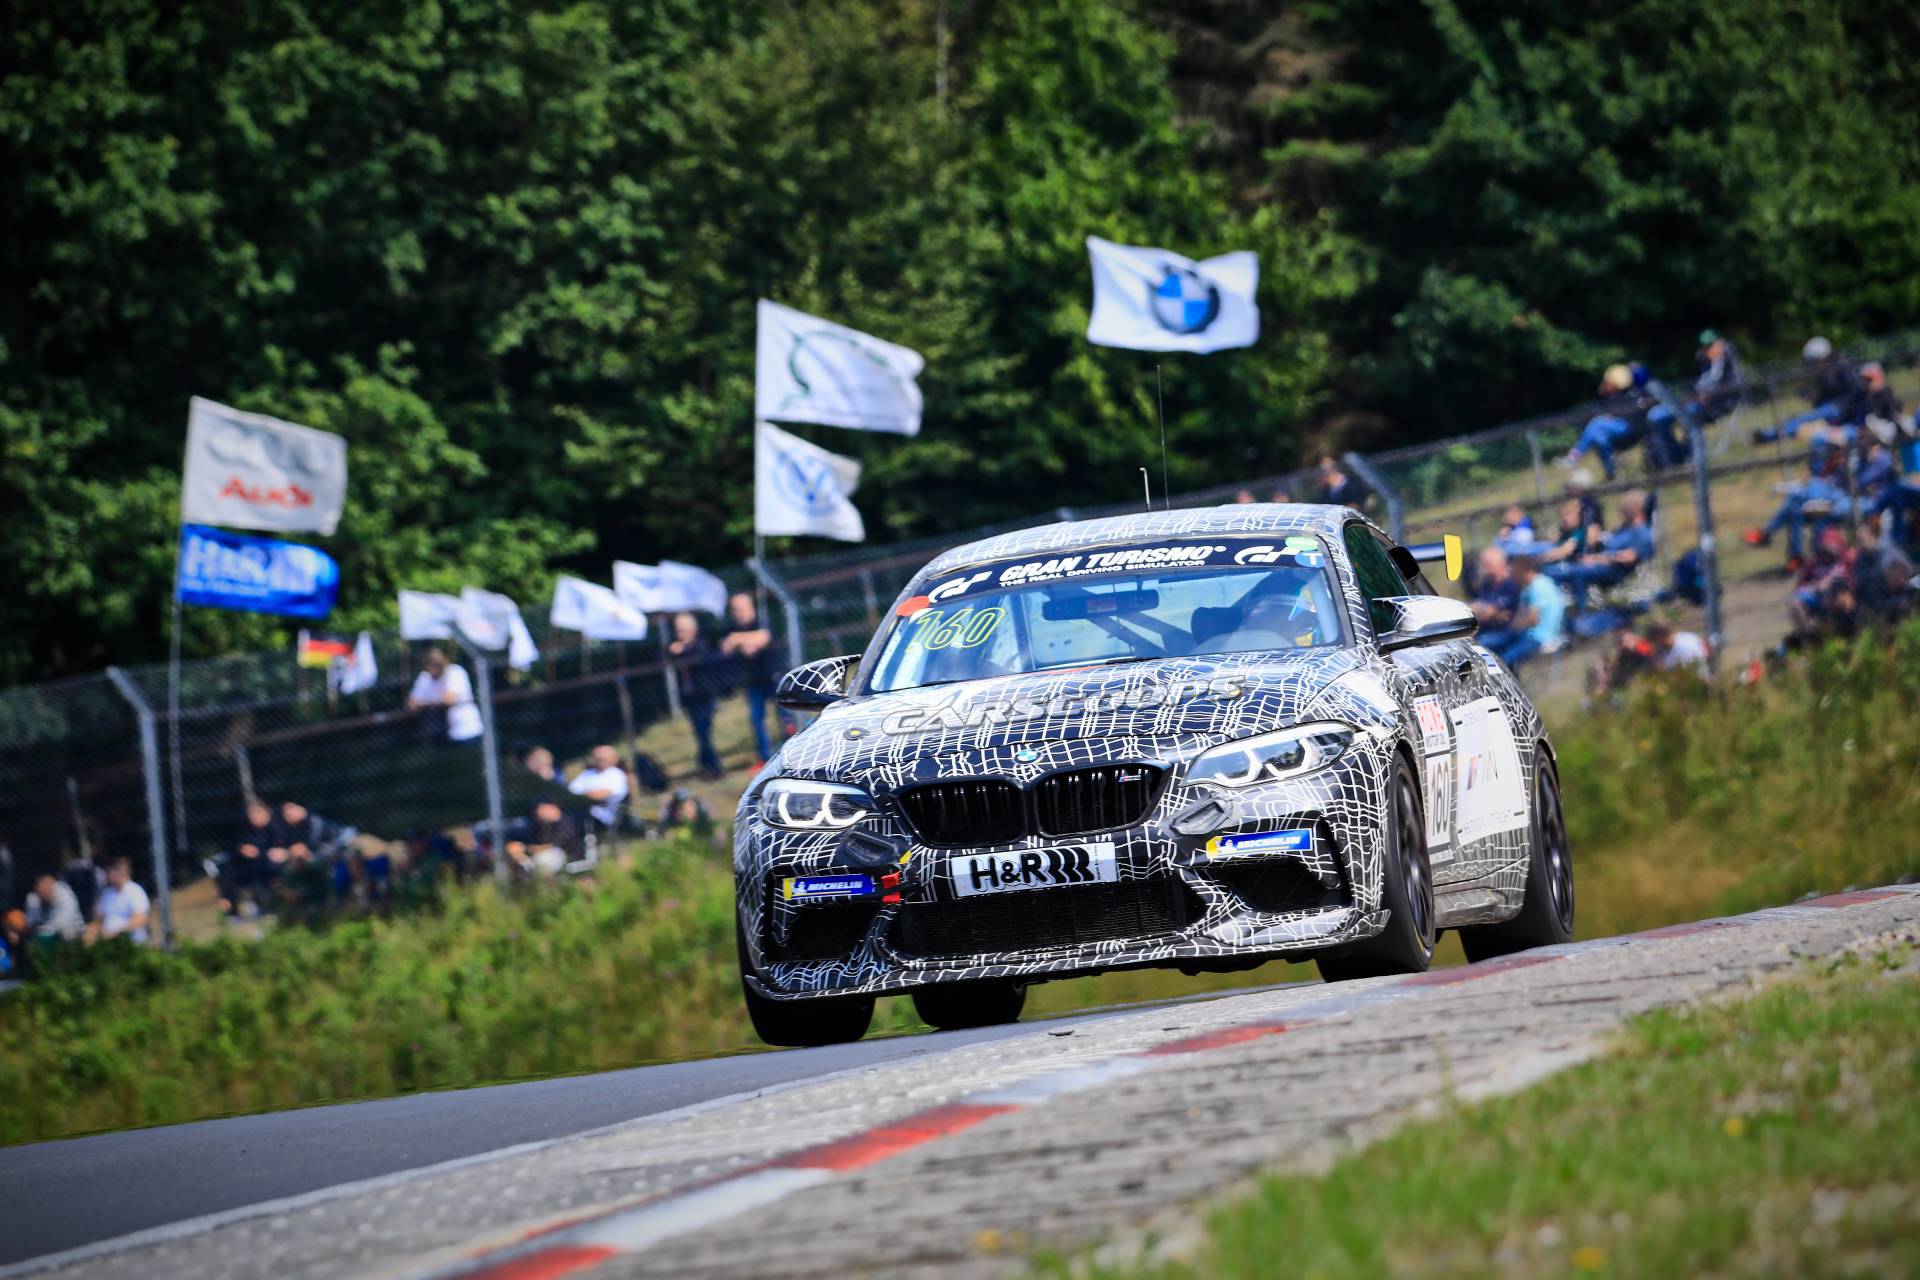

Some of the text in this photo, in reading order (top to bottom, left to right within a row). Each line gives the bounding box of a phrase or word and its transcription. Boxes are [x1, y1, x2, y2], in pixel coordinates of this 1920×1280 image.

[999, 545, 1215, 582] GRAN TURISMO
[999, 559, 1206, 588] THE REAL DRIVING SIMULATOR
[1302, 552, 1324, 566] T
[904, 607, 1006, 655] 160
[881, 675, 1247, 737] CARSCOOPS
[1431, 761, 1450, 837] 160
[807, 881, 863, 892] MICHELIN
